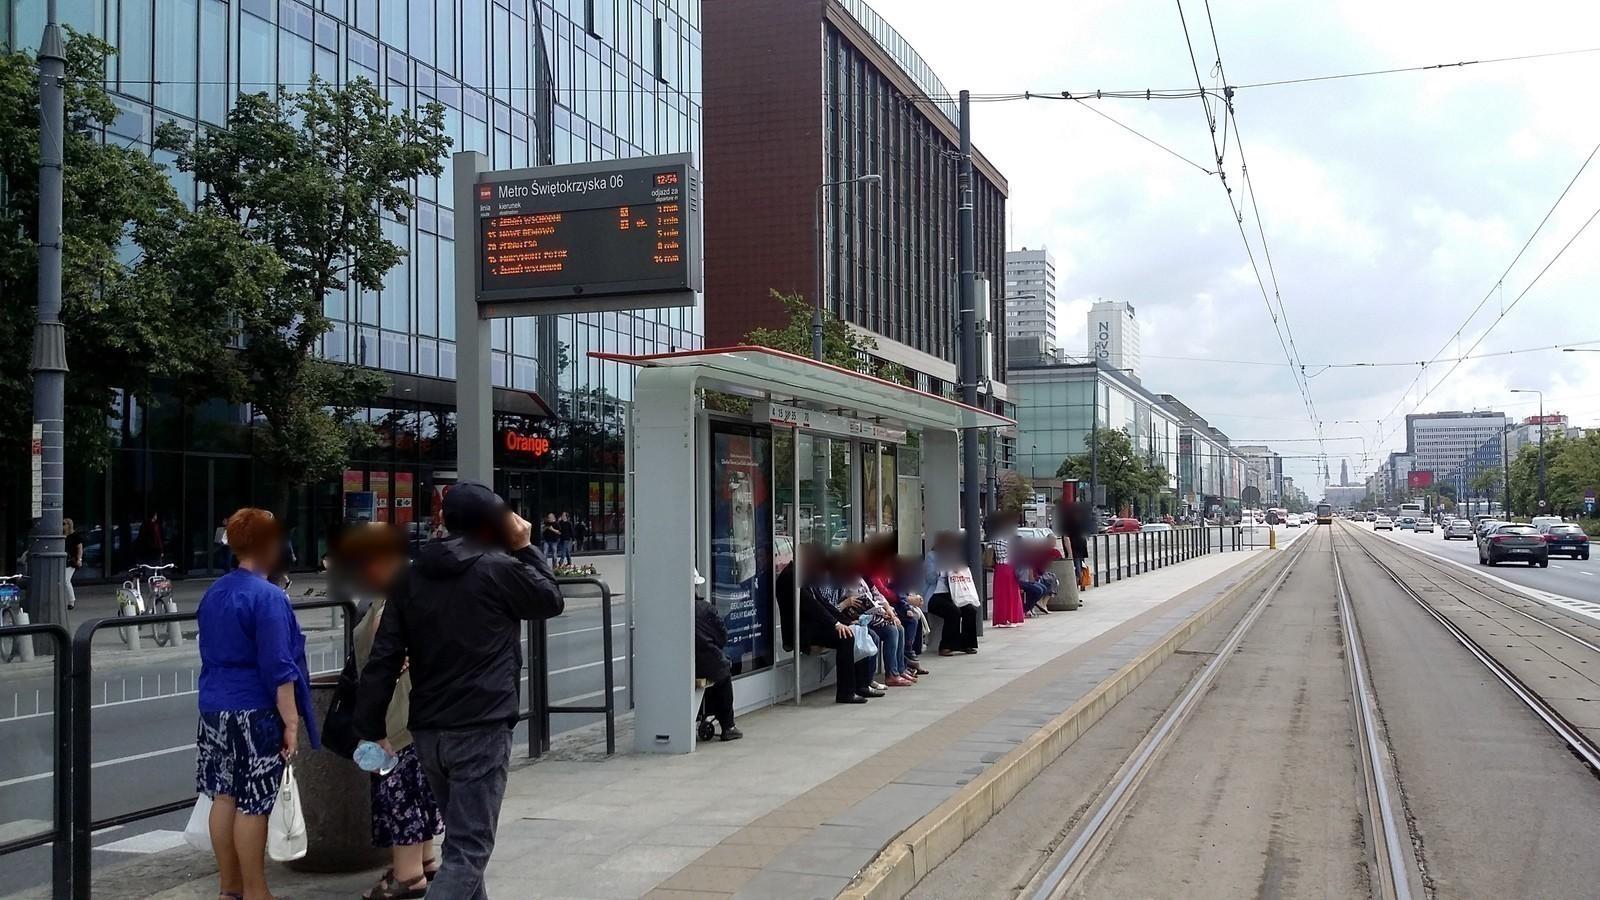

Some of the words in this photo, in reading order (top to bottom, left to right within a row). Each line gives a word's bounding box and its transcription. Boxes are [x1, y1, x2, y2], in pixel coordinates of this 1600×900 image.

[498, 184, 528, 199] Metro
[531, 177, 607, 197] Świętokrzyska
[610, 174, 624, 188] 06
[651, 189, 670, 200] odjazd
[499, 201, 522, 211] kierunek
[1099, 321, 1109, 361] NOVO
[507, 431, 549, 456] Orange
